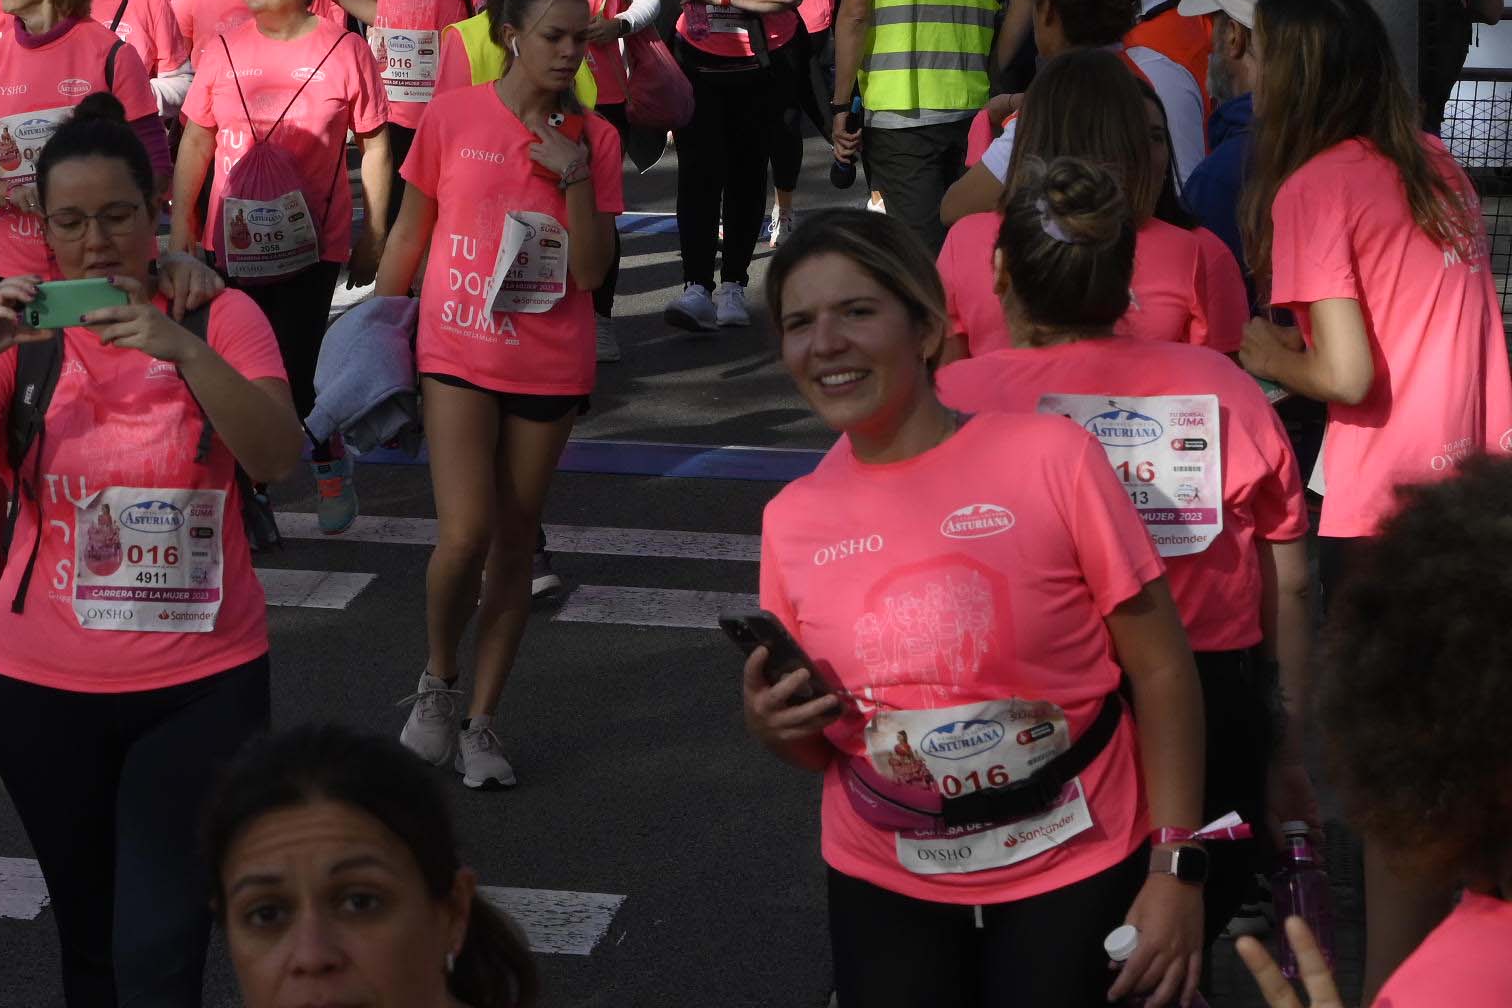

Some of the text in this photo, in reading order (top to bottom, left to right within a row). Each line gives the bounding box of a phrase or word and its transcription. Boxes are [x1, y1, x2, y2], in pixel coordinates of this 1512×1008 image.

[389, 57, 412, 69] 016
[391, 70, 409, 79] 19011
[221, 128, 243, 148] TU
[460, 147, 505, 165] OYSHO
[253, 231, 284, 242] 016
[449, 233, 476, 260] TU
[441, 300, 517, 337] SUMA
[1090, 422, 1158, 438] ASTURIANA
[1170, 417, 1206, 427] SUMA
[1116, 460, 1156, 484] 16
[43, 473, 87, 509] TU
[190, 509, 214, 518] SUMA
[1179, 512, 1203, 521] 2023
[946, 515, 1011, 533] ASTURIANA
[127, 545, 179, 566] 016
[813, 534, 884, 567] OYSHO
[136, 571, 168, 585] 4911
[91, 588, 133, 599] CARRERA
[134, 590, 147, 599] DE
[148, 591, 161, 599] LA
[162, 591, 191, 600] MUJER
[87, 608, 134, 621] OYSHO
[927, 728, 1001, 754] ASTURIANA
[941, 763, 1010, 799] 016
[1017, 813, 1075, 844] Santander
[917, 845, 972, 861] OYSHO
